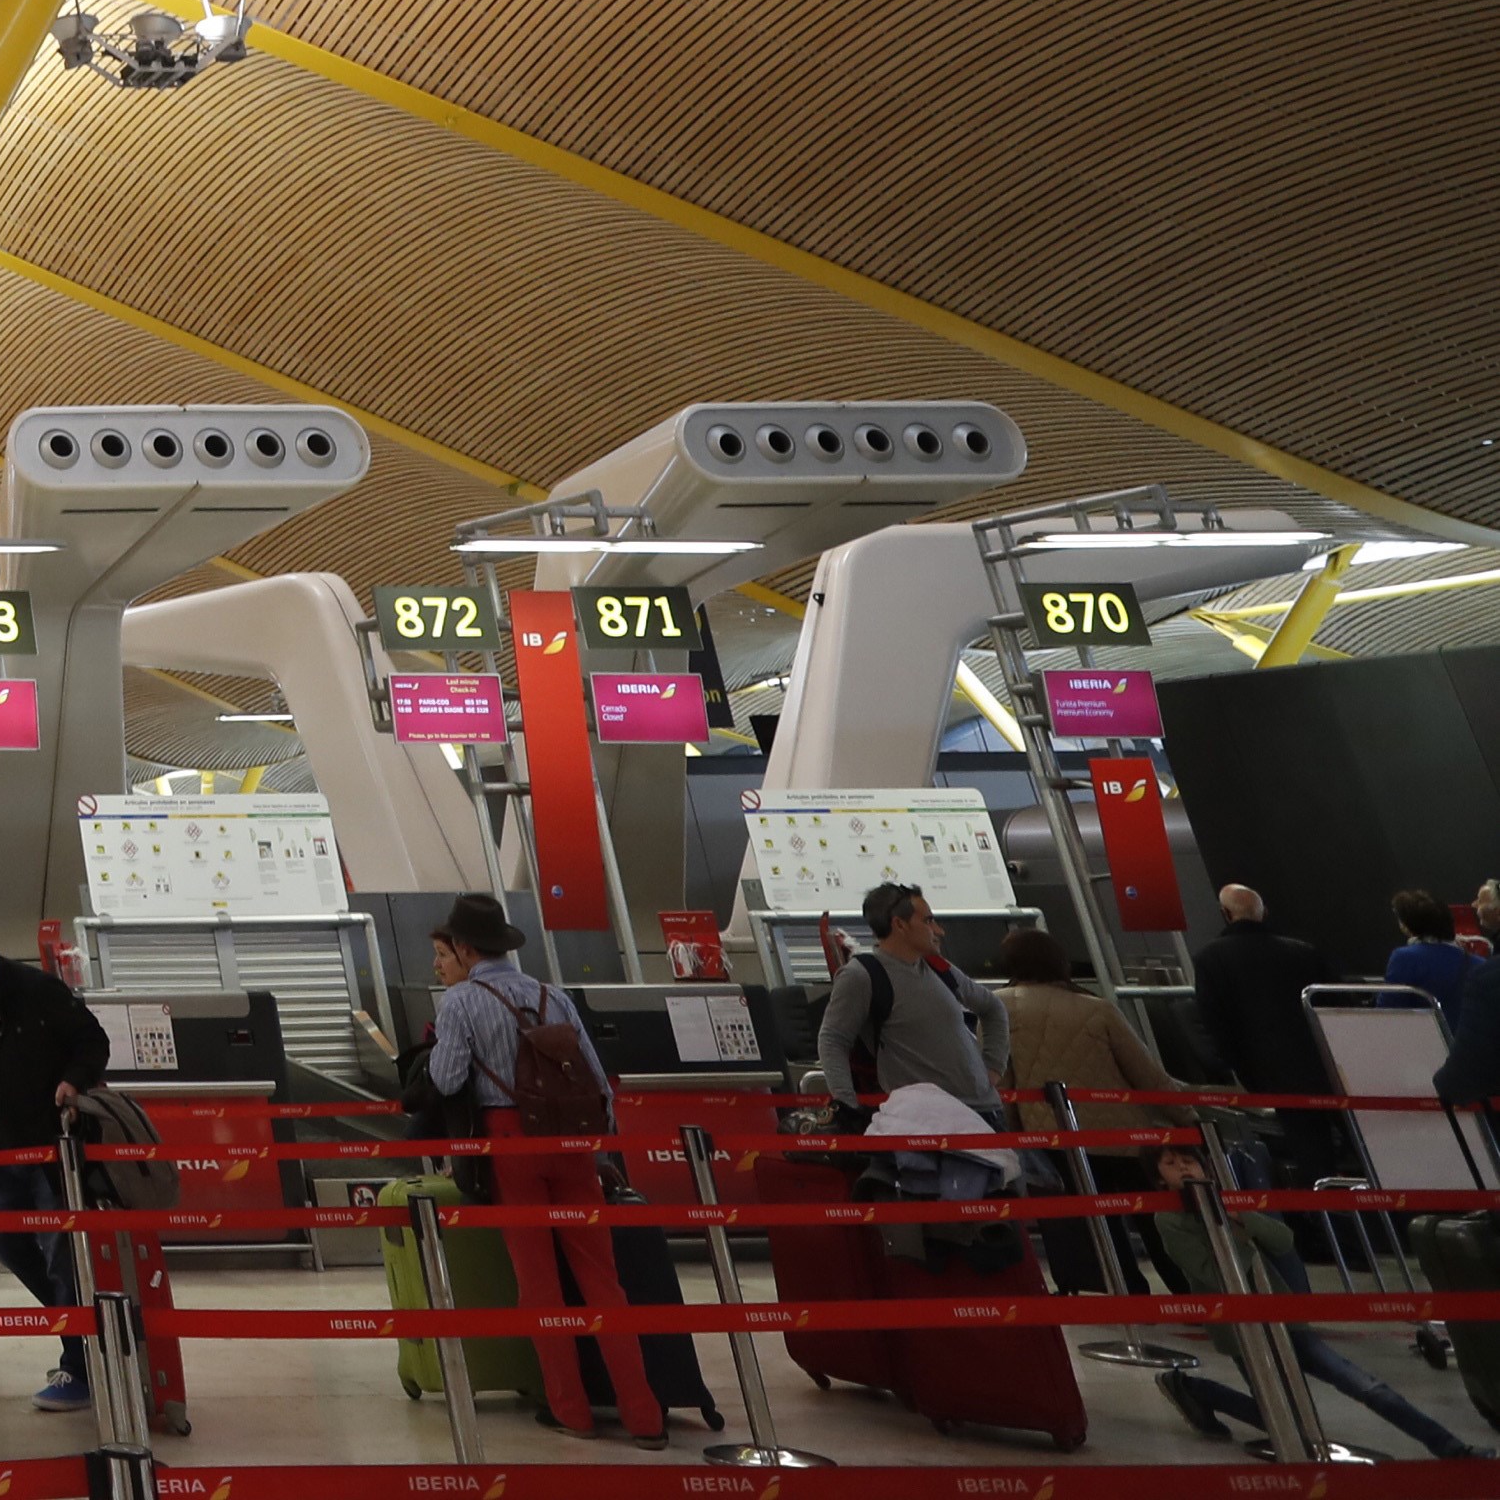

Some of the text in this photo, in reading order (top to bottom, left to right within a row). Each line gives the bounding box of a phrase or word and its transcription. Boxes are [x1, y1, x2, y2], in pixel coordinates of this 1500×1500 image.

[395, 597, 482, 637] 872
[597, 597, 681, 637] 871
[1043, 593, 1128, 633] 870
[523, 633, 542, 646] IB
[617, 684, 660, 694] IBERIA
[1069, 679, 1112, 689] IBERIA
[601, 704, 627, 713] Cerrado
[602, 713, 624, 722] Closed
[1103, 782, 1122, 794] IB
[15, 1151, 44, 1161] IBERIA
[1094, 1198, 1131, 1208] IBERIA
[1355, 1194, 1393, 1204] IBERIA
[960, 1204, 997, 1214] IBERIA
[548, 1210, 586, 1220] IBERIA
[953, 1306, 1001, 1318] IBERIA
[1159, 1303, 1207, 1314] IBERIA
[1369, 1302, 1416, 1313] IBERIA
[539, 1316, 586, 1327] IBERIA
[745, 1311, 792, 1322] IBERIA
[745, 1311, 792, 1322] IBERIA
[330, 1319, 377, 1330] IBERIA
[157, 1479, 206, 1493] ERIA
[408, 1476, 480, 1491] IBERIA
[682, 1477, 754, 1492] IBERIA
[956, 1478, 1029, 1493] IBERIA
[1229, 1475, 1301, 1491] IBERIA
